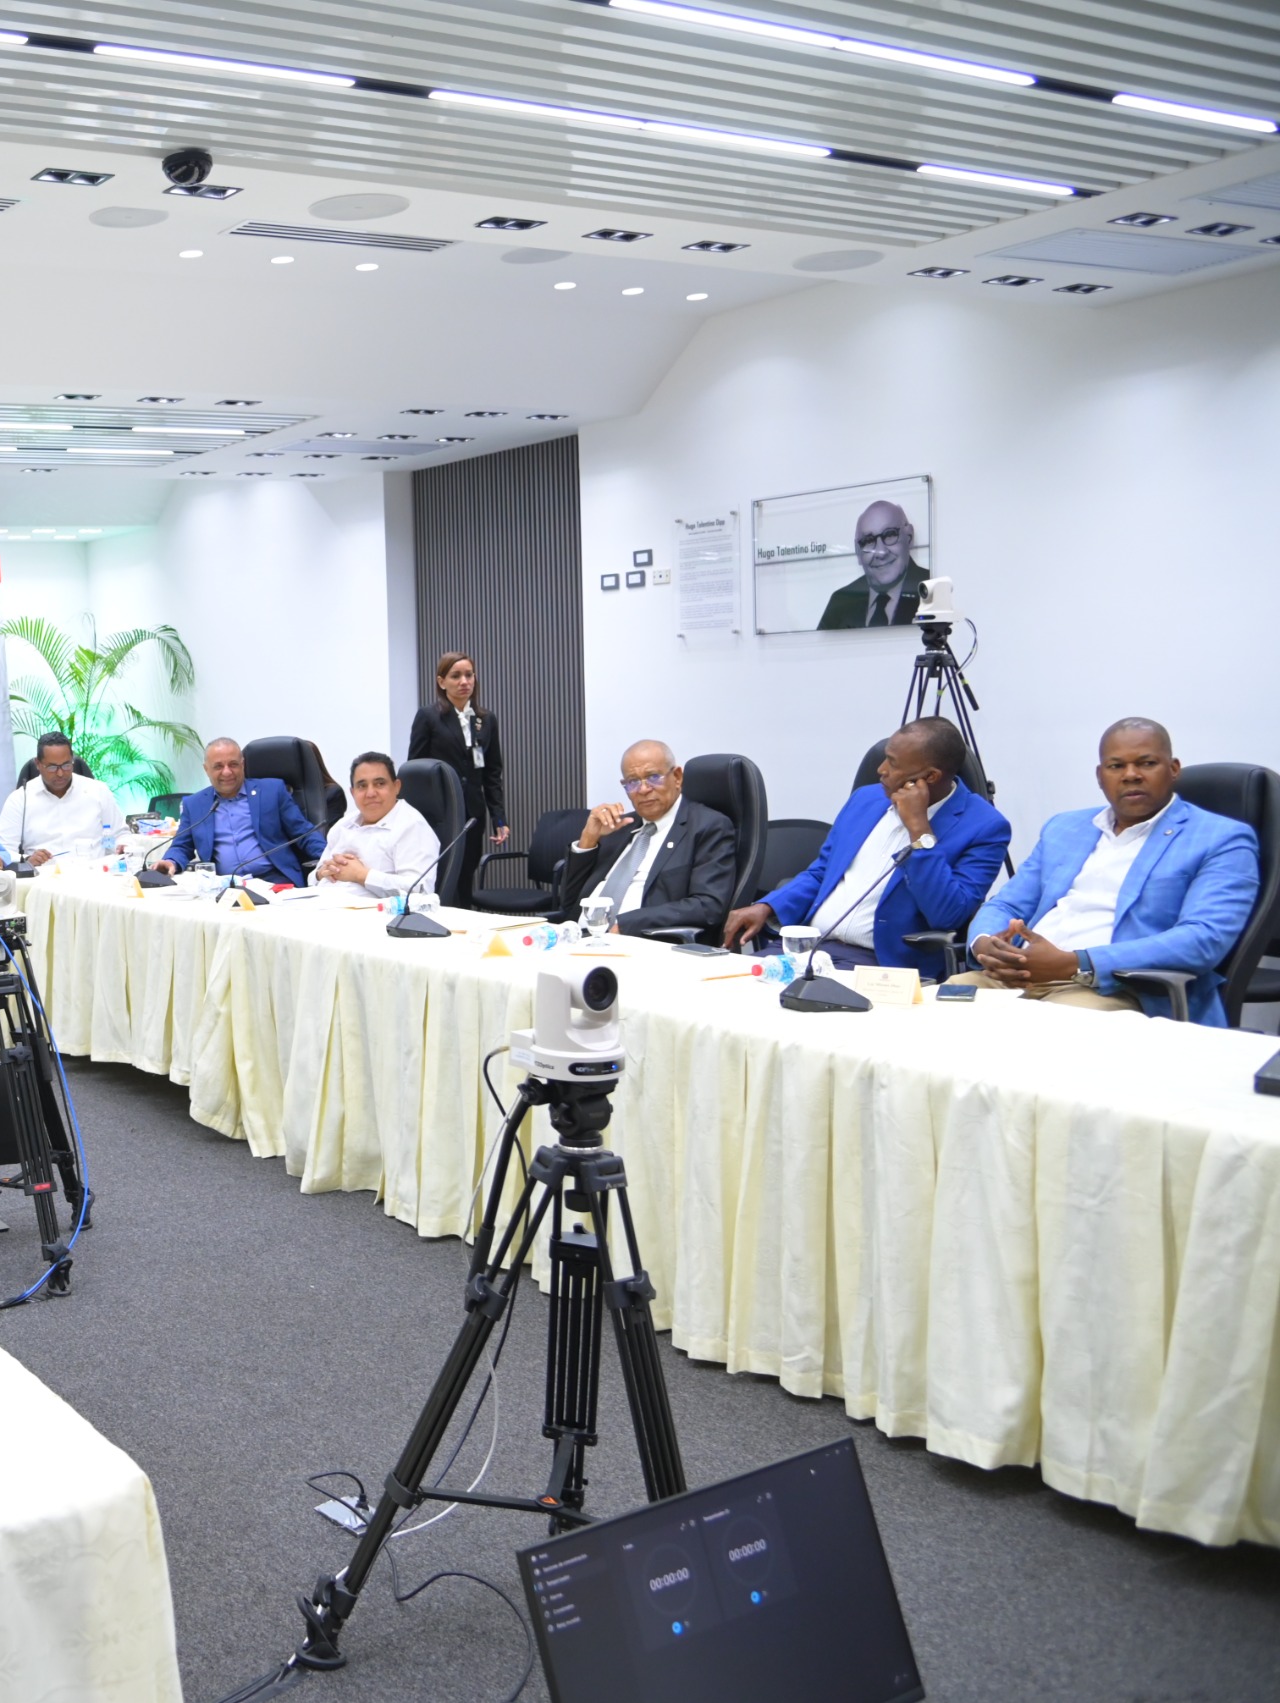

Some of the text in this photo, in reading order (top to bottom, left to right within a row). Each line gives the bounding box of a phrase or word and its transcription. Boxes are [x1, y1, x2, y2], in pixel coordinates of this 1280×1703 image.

[757, 541, 827, 560] Hugo Tolentino Dipp
[729, 1538, 767, 1562] 00:00:00
[649, 1567, 690, 1592] 00:00:00
